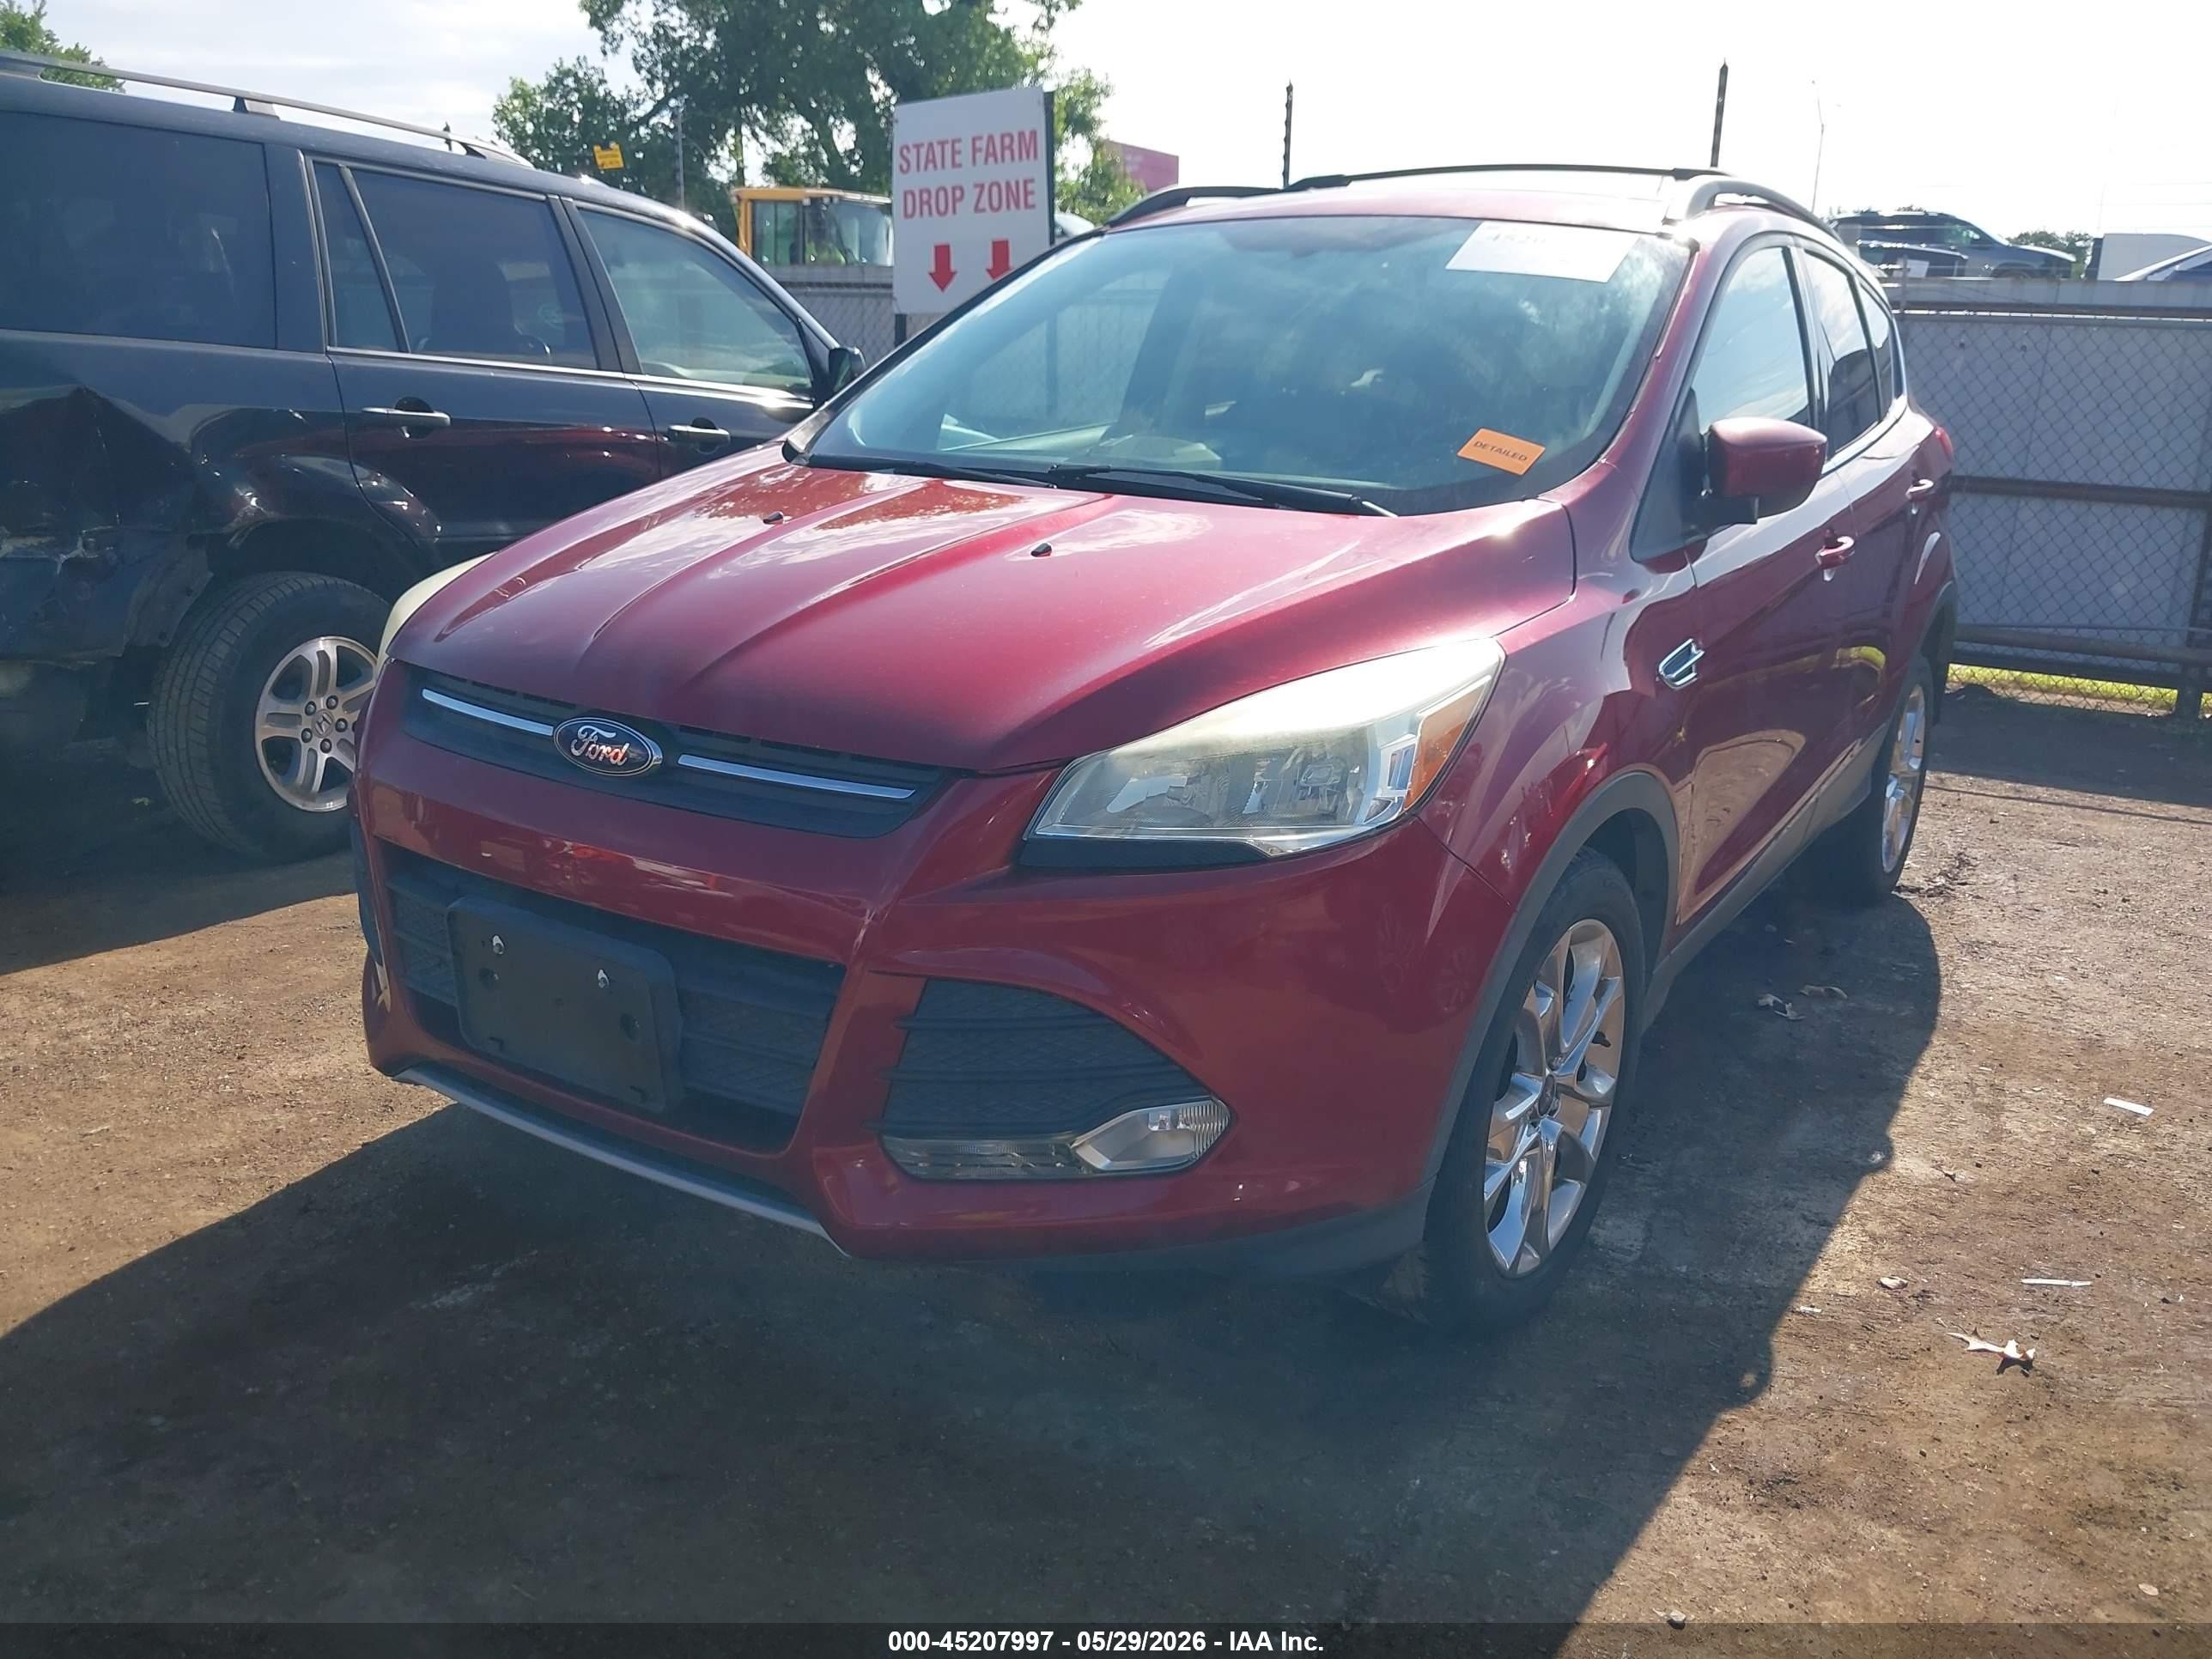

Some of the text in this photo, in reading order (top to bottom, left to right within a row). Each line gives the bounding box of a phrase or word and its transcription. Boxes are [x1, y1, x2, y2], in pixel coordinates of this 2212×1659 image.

[899, 130, 1038, 174] STATE FARM
[902, 179, 1036, 220] DROP ZONE
[1474, 441, 1528, 462] DETAILED
[570, 725, 630, 766] Ford
